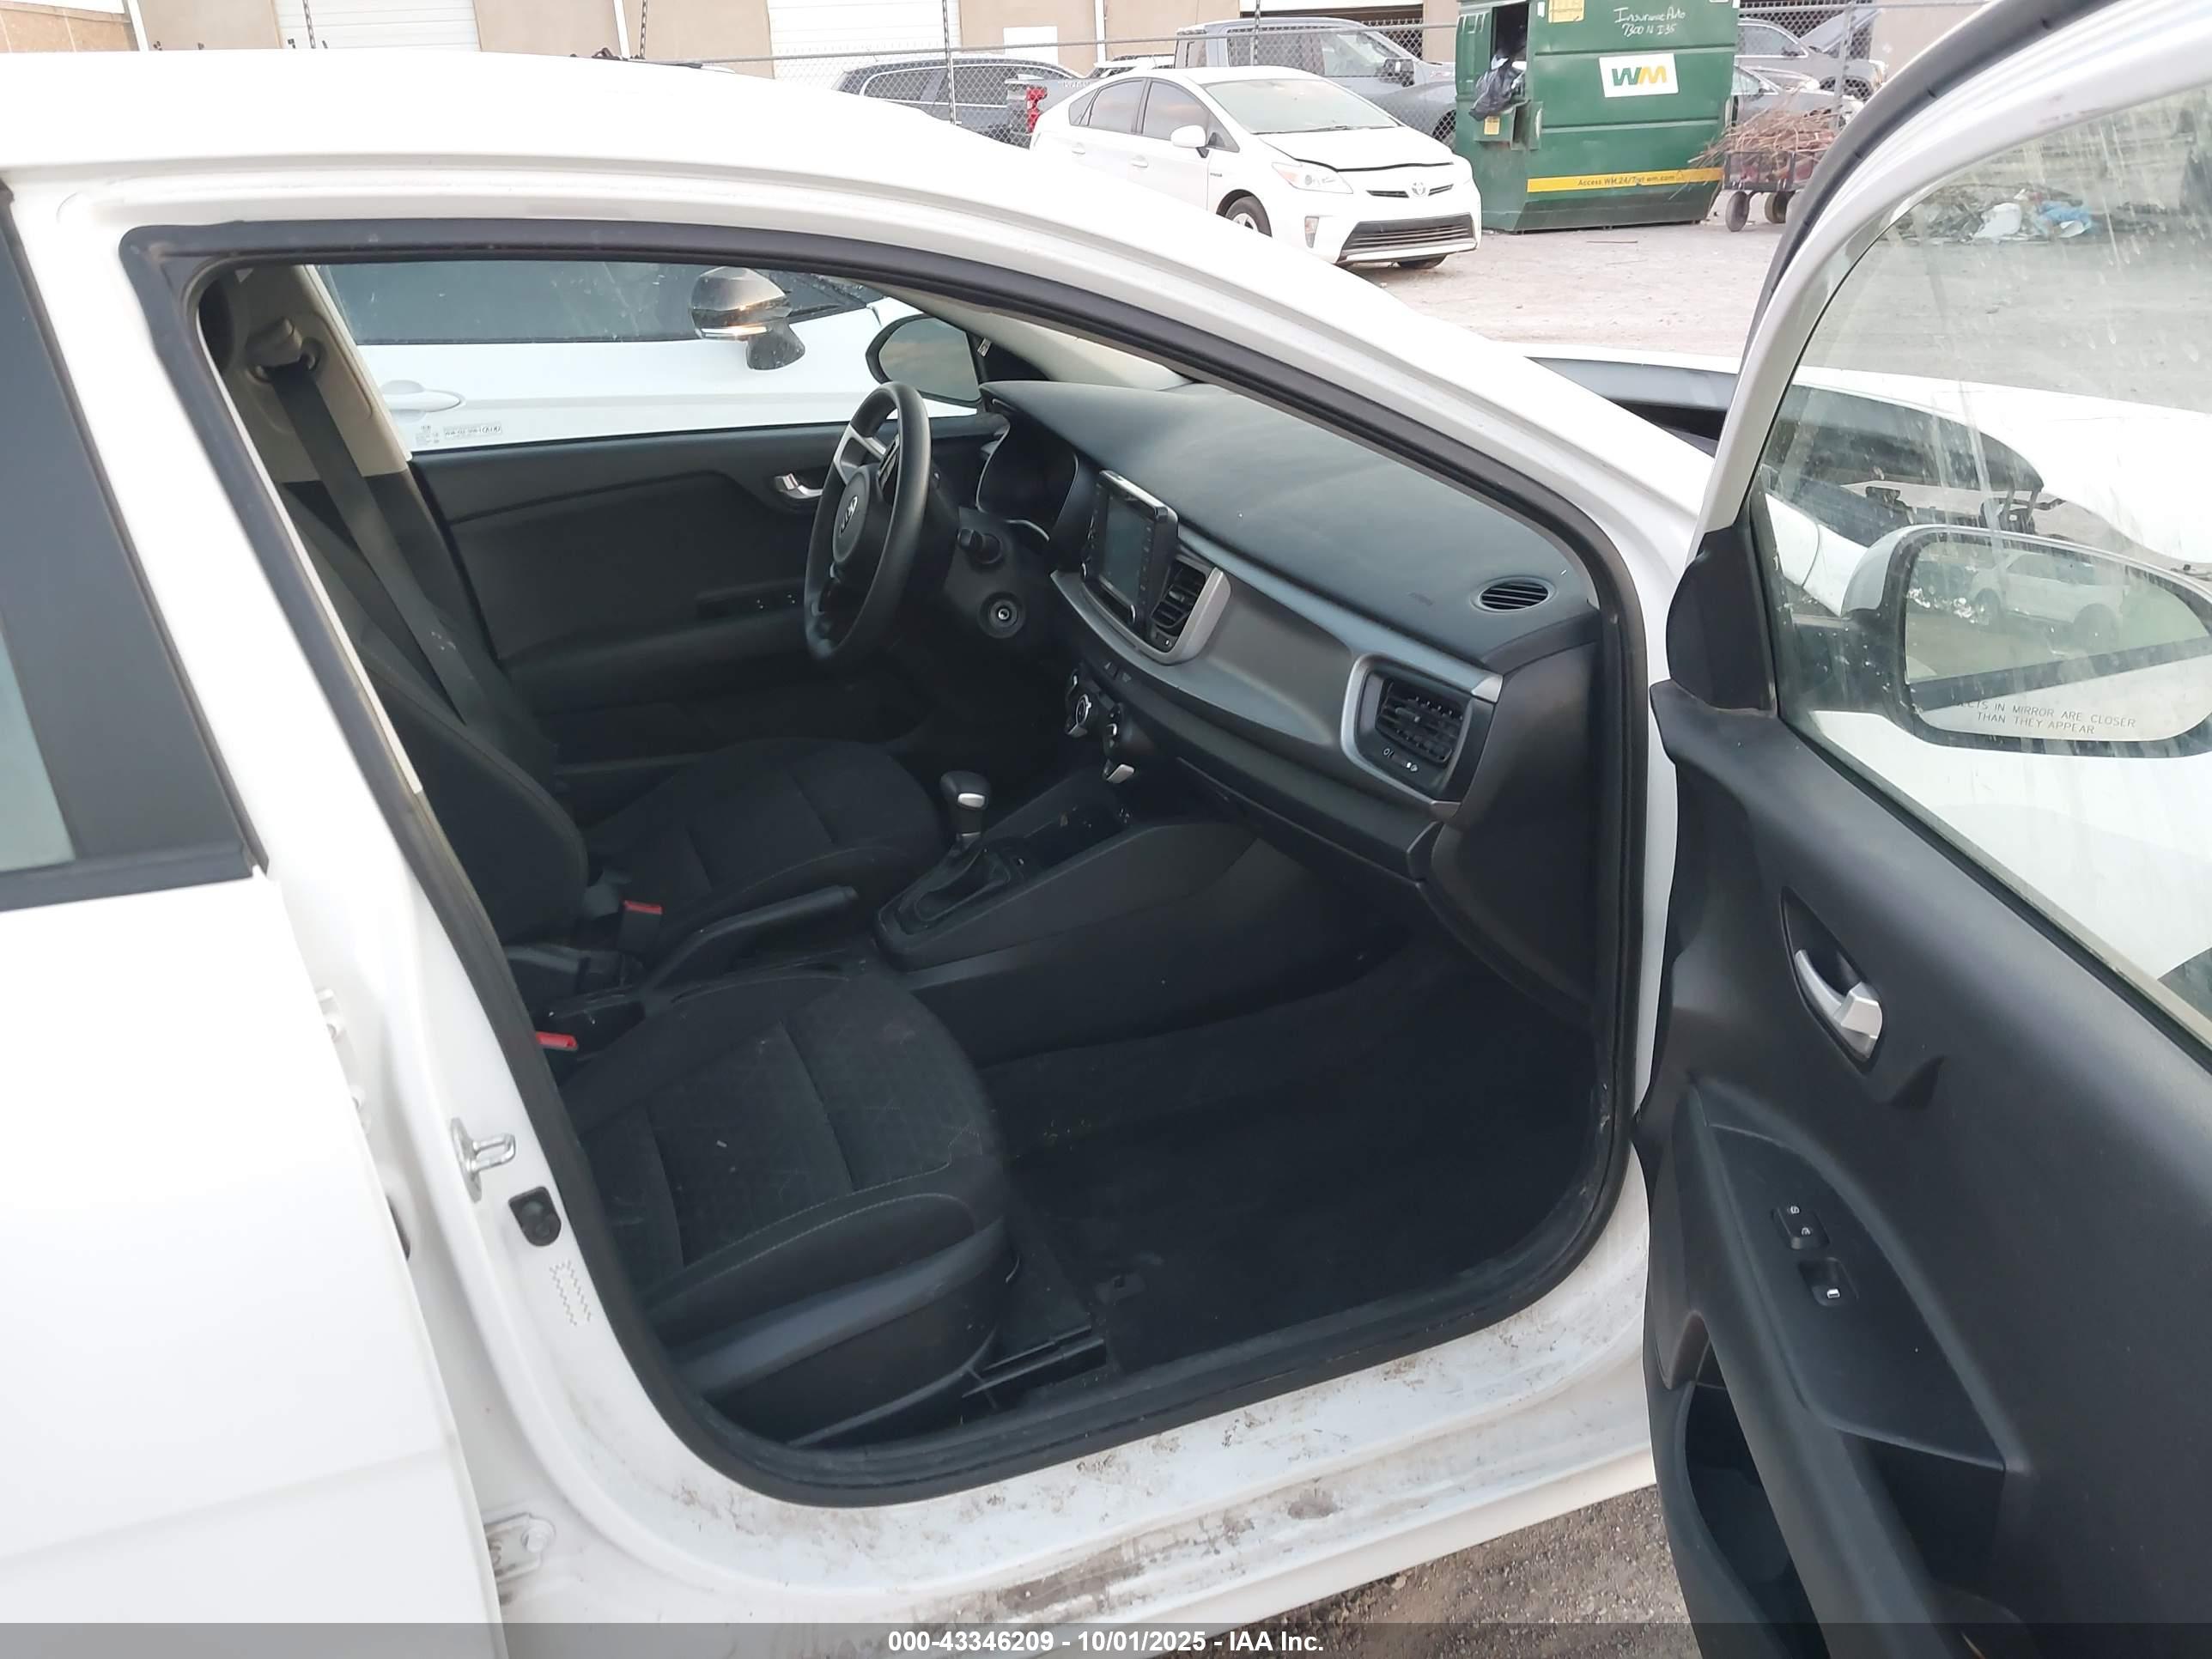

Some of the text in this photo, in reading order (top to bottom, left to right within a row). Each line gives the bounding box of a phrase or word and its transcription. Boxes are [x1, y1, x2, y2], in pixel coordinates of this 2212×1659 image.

[1611, 65, 1668, 87] WM
[1577, 178, 1601, 186] Access
[1978, 712, 2095, 735] THAN THEY APPEAR
[1995, 702, 2006, 713] IN
[2012, 705, 2055, 718] MIRROR
[2061, 710, 2082, 722] ARE
[2090, 714, 2136, 728] CLOSER
